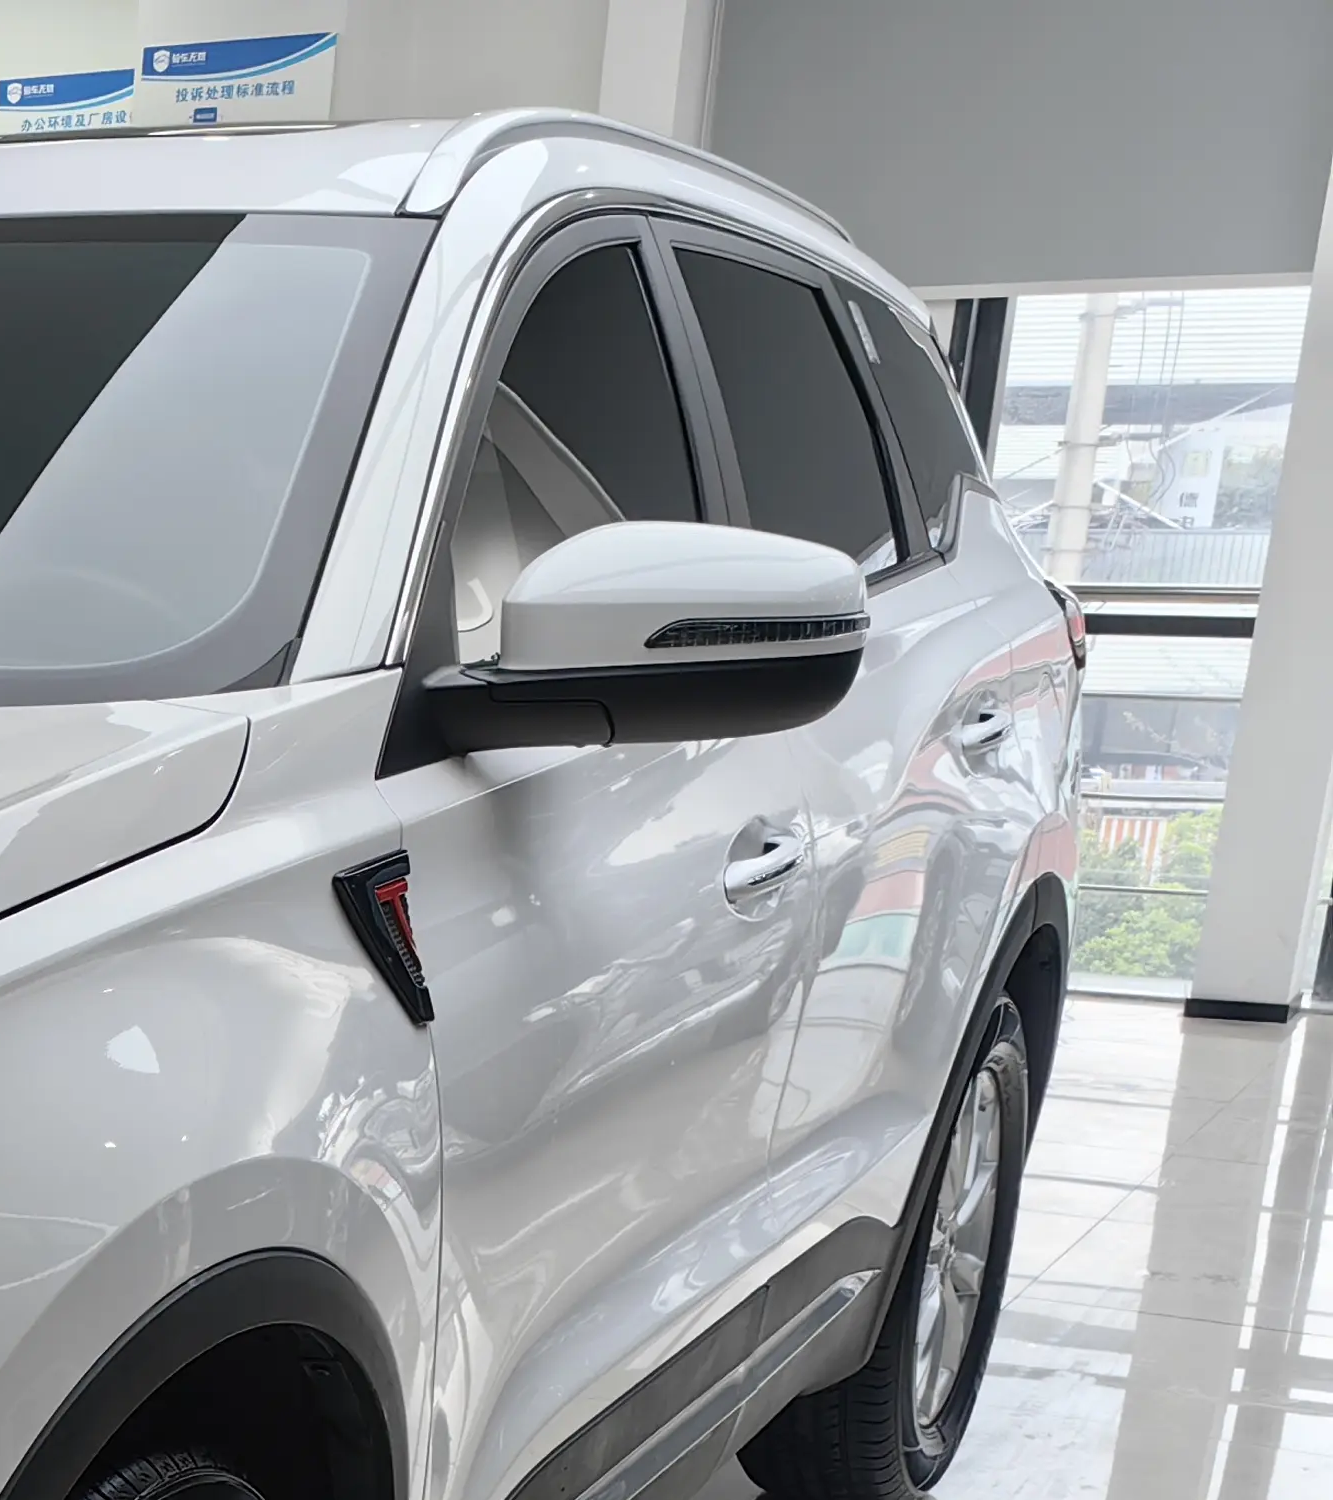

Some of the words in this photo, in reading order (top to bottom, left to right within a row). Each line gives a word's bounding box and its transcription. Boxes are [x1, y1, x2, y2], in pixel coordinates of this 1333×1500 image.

[176, 80, 296, 103] 投诉处理标准流程
